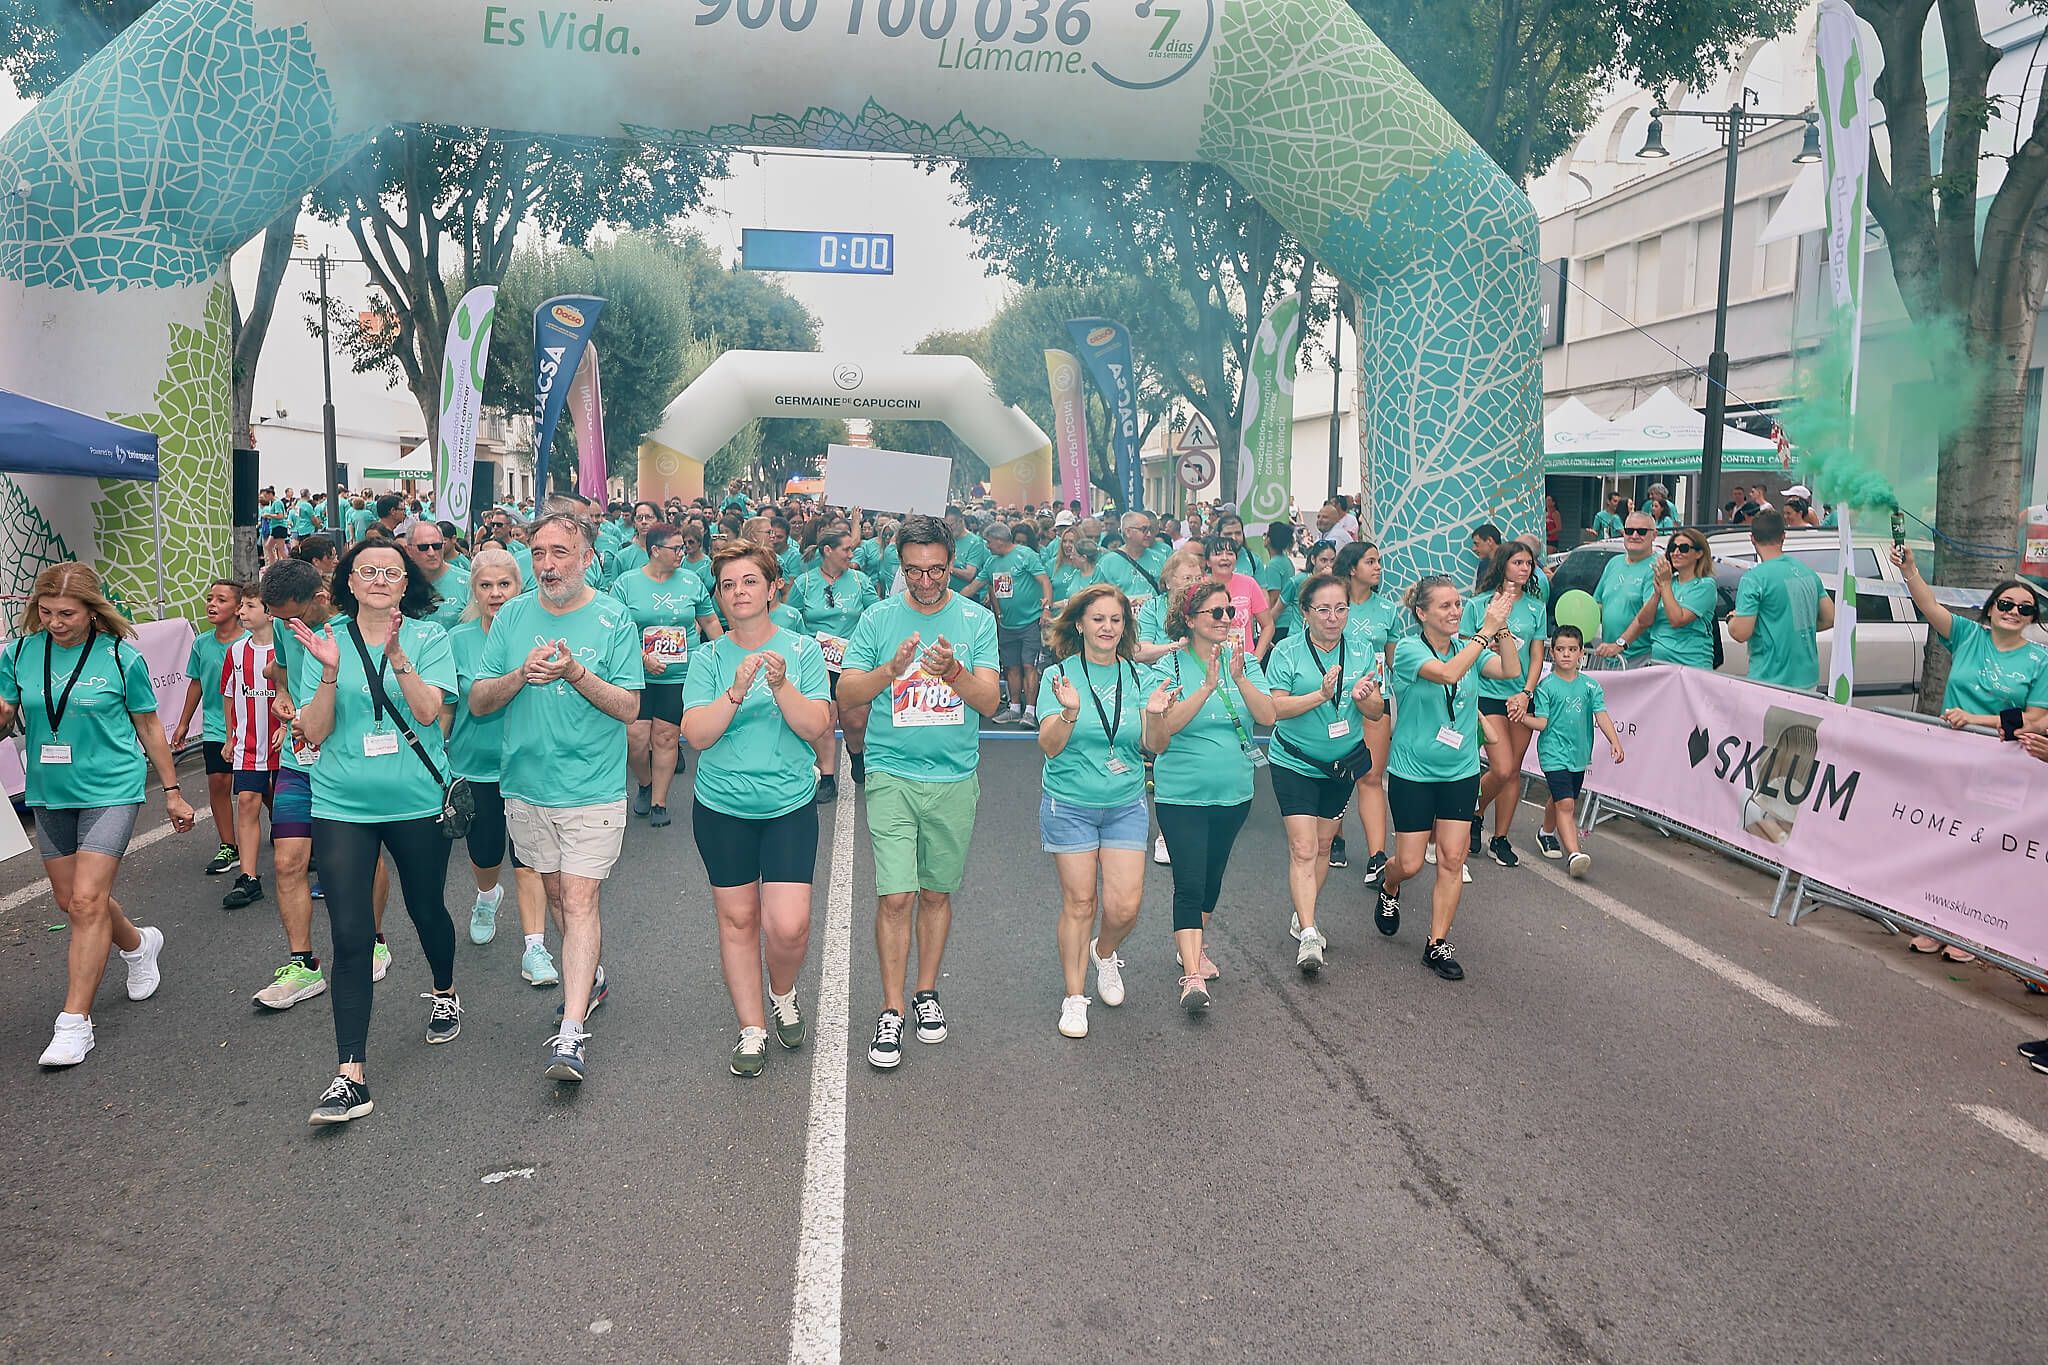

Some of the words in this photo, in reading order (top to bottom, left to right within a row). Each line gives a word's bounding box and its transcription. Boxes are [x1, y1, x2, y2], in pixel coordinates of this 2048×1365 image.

[483, 6, 526, 47] Es
[538, 10, 641, 56] Vida.
[846, 0, 957, 40] 100
[974, 0, 1092, 46] 036
[1150, 9, 1181, 50] 7
[937, 37, 1088, 75] Llámame.
[1166, 39, 1193, 53] días
[820, 236, 888, 269] 0:00
[556, 307, 582, 324] Dacsa
[534, 347, 566, 425] DACSA
[775, 396, 841, 407] GERMAINE
[853, 398, 921, 409] CAPUCCINI
[1275, 416, 1286, 461] Valencia
[1621, 455, 1673, 466] ASOCIACIÓN
[1721, 455, 1755, 464] CONTRA
[907, 683, 952, 708] 1788
[1714, 735, 1861, 821] SKLUM
[1892, 802, 1962, 837] HOME
[1970, 827, 1984, 843] &
[2002, 833, 2048, 863] DE
[1924, 891, 2009, 930] www.sklum.com
